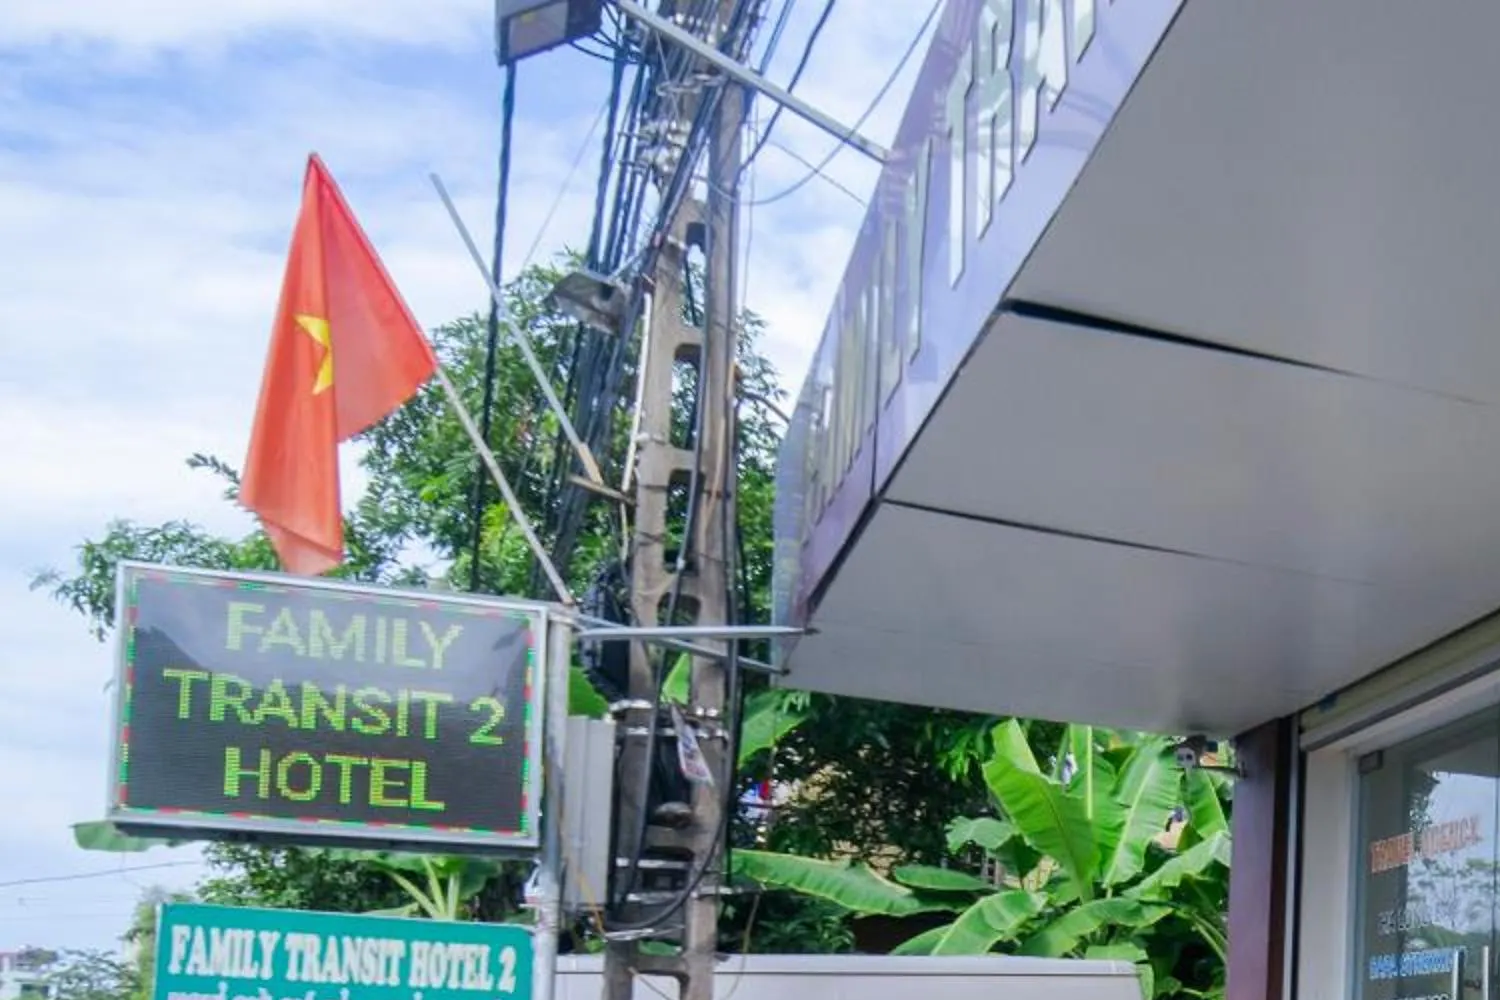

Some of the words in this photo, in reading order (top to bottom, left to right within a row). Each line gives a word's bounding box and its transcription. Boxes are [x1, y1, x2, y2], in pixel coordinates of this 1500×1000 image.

[225, 601, 463, 669] FAMILY
[163, 668, 453, 739] TRANSIT
[468, 697, 505, 745] 2
[223, 747, 445, 811] HOTEL
[167, 924, 280, 981] FAMILY
[285, 933, 406, 987] TRANSIT
[409, 939, 495, 993] HOTEL
[499, 945, 518, 994] 2
